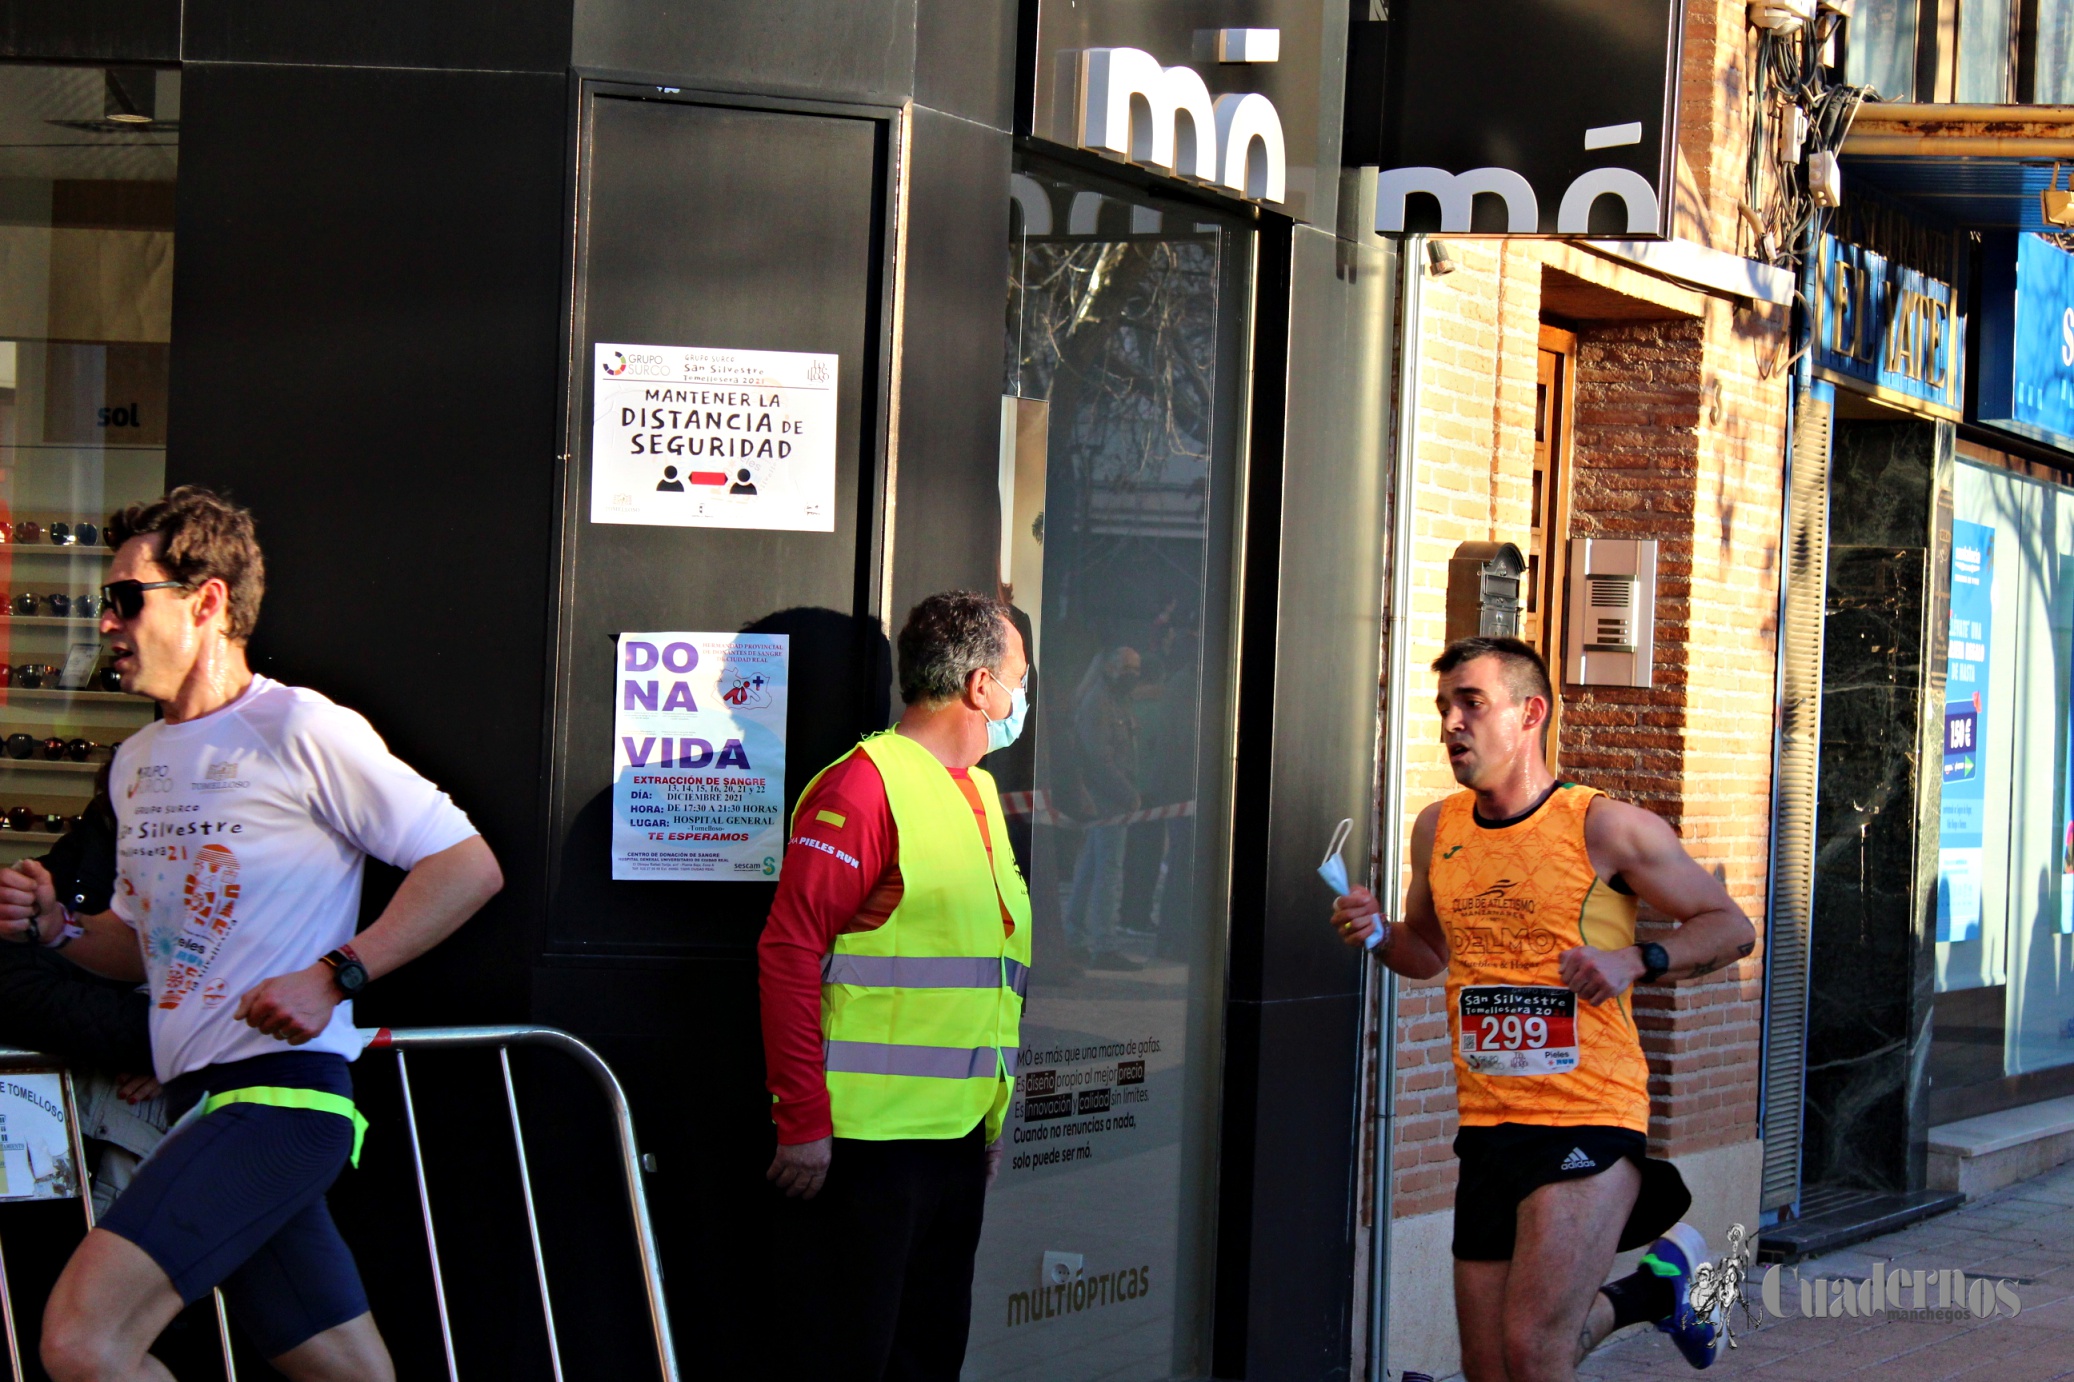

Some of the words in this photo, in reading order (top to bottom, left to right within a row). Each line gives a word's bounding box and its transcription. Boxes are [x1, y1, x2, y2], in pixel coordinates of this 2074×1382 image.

[1832, 260, 1874, 364] EL
[1883, 281, 1947, 388] YATE
[628, 354, 663, 364] GRUPO
[628, 364, 670, 376] SURCO
[684, 364, 705, 372] San
[710, 365, 764, 375] Silvestre
[683, 375, 739, 384] Tomellosera
[645, 389, 751, 407] MANTENER
[759, 394, 780, 408] LA
[97, 403, 140, 427] sol
[621, 407, 772, 432] DISTANCIA
[782, 420, 803, 435] DE
[630, 434, 792, 458] SEGURIDAD
[624, 641, 699, 674] DO
[623, 680, 699, 712] NA
[1950, 720, 1964, 749] 150
[1964, 718, 1972, 748] €
[621, 737, 751, 769] VIDA
[633, 775, 703, 785] EXTRACCIÓN
[706, 777, 720, 785] DE
[723, 777, 766, 786] SANGRE
[631, 789, 652, 799] DÍA:
[667, 794, 721, 802] DICIEMBRE
[724, 794, 743, 802] 2021
[737, 785, 747, 793] 21
[749, 787, 754, 795] y
[756, 785, 766, 794] 22
[165, 805, 200, 814] SURCO
[630, 805, 664, 814] HORA:
[683, 805, 706, 813] 17:30
[708, 805, 716, 813] A
[718, 805, 741, 813] 21:30
[743, 805, 778, 813] HORAS
[630, 819, 670, 828] LUGAR:
[673, 815, 724, 825] HOSPITAL
[726, 816, 774, 825] GENERAL
[137, 821, 243, 839] Silvestre
[648, 832, 664, 840] TE
[668, 832, 749, 841] ESPERAMOS
[168, 845, 188, 861] 21
[799, 837, 835, 855] PIELES
[836, 850, 860, 869] RUN
[1475, 898, 1486, 909] DE
[1487, 898, 1536, 914] ATLETISMO
[178, 937, 206, 954] eles
[1500, 961, 1507, 969] &
[1510, 960, 1539, 971] Hogar
[1465, 995, 1488, 1006] San
[1493, 994, 1566, 1007] Silvestre
[1465, 1006, 1531, 1015] Tomellosera
[1535, 1007, 1566, 1016] 2021
[1481, 1015, 1548, 1050] 299
[1017, 1045, 1033, 1067] MÓ
[1034, 1054, 1044, 1065] es
[1045, 1044, 1063, 1063] más
[1064, 1049, 1080, 1066] que
[1081, 1047, 1097, 1060] una
[1100, 1046, 1125, 1058] marca
[1126, 1039, 1137, 1055] de
[1138, 1037, 1162, 1058] gafas.
[1545, 1051, 1570, 1059] Pieles
[1016, 1075, 1025, 1093] Es
[1027, 1073, 1055, 1092] diseño
[1056, 1069, 1082, 1092] propio
[1084, 1068, 1093, 1084] al
[1094, 1066, 1118, 1085] mejor
[7, 1083, 64, 1123] TOMELLOSO
[1015, 1101, 1024, 1119] Es
[1025, 1094, 1072, 1118] innovación
[1072, 1098, 1078, 1116] y
[1079, 1089, 1110, 1110] calidad
[1111, 1089, 1122, 1106] sin
[1013, 1123, 1048, 1144] Cuando
[1050, 1125, 1061, 1138] no
[1063, 1116, 1104, 1137] renuncias
[1106, 1120, 1111, 1130] a
[1113, 1112, 1136, 1130] nada,
[1012, 1151, 1031, 1170] solo
[1032, 1147, 1060, 1171] puede
[1062, 1148, 1075, 1162] ser
[1077, 1141, 1092, 1160] mó.
[1561, 1160, 1596, 1170] adidas
